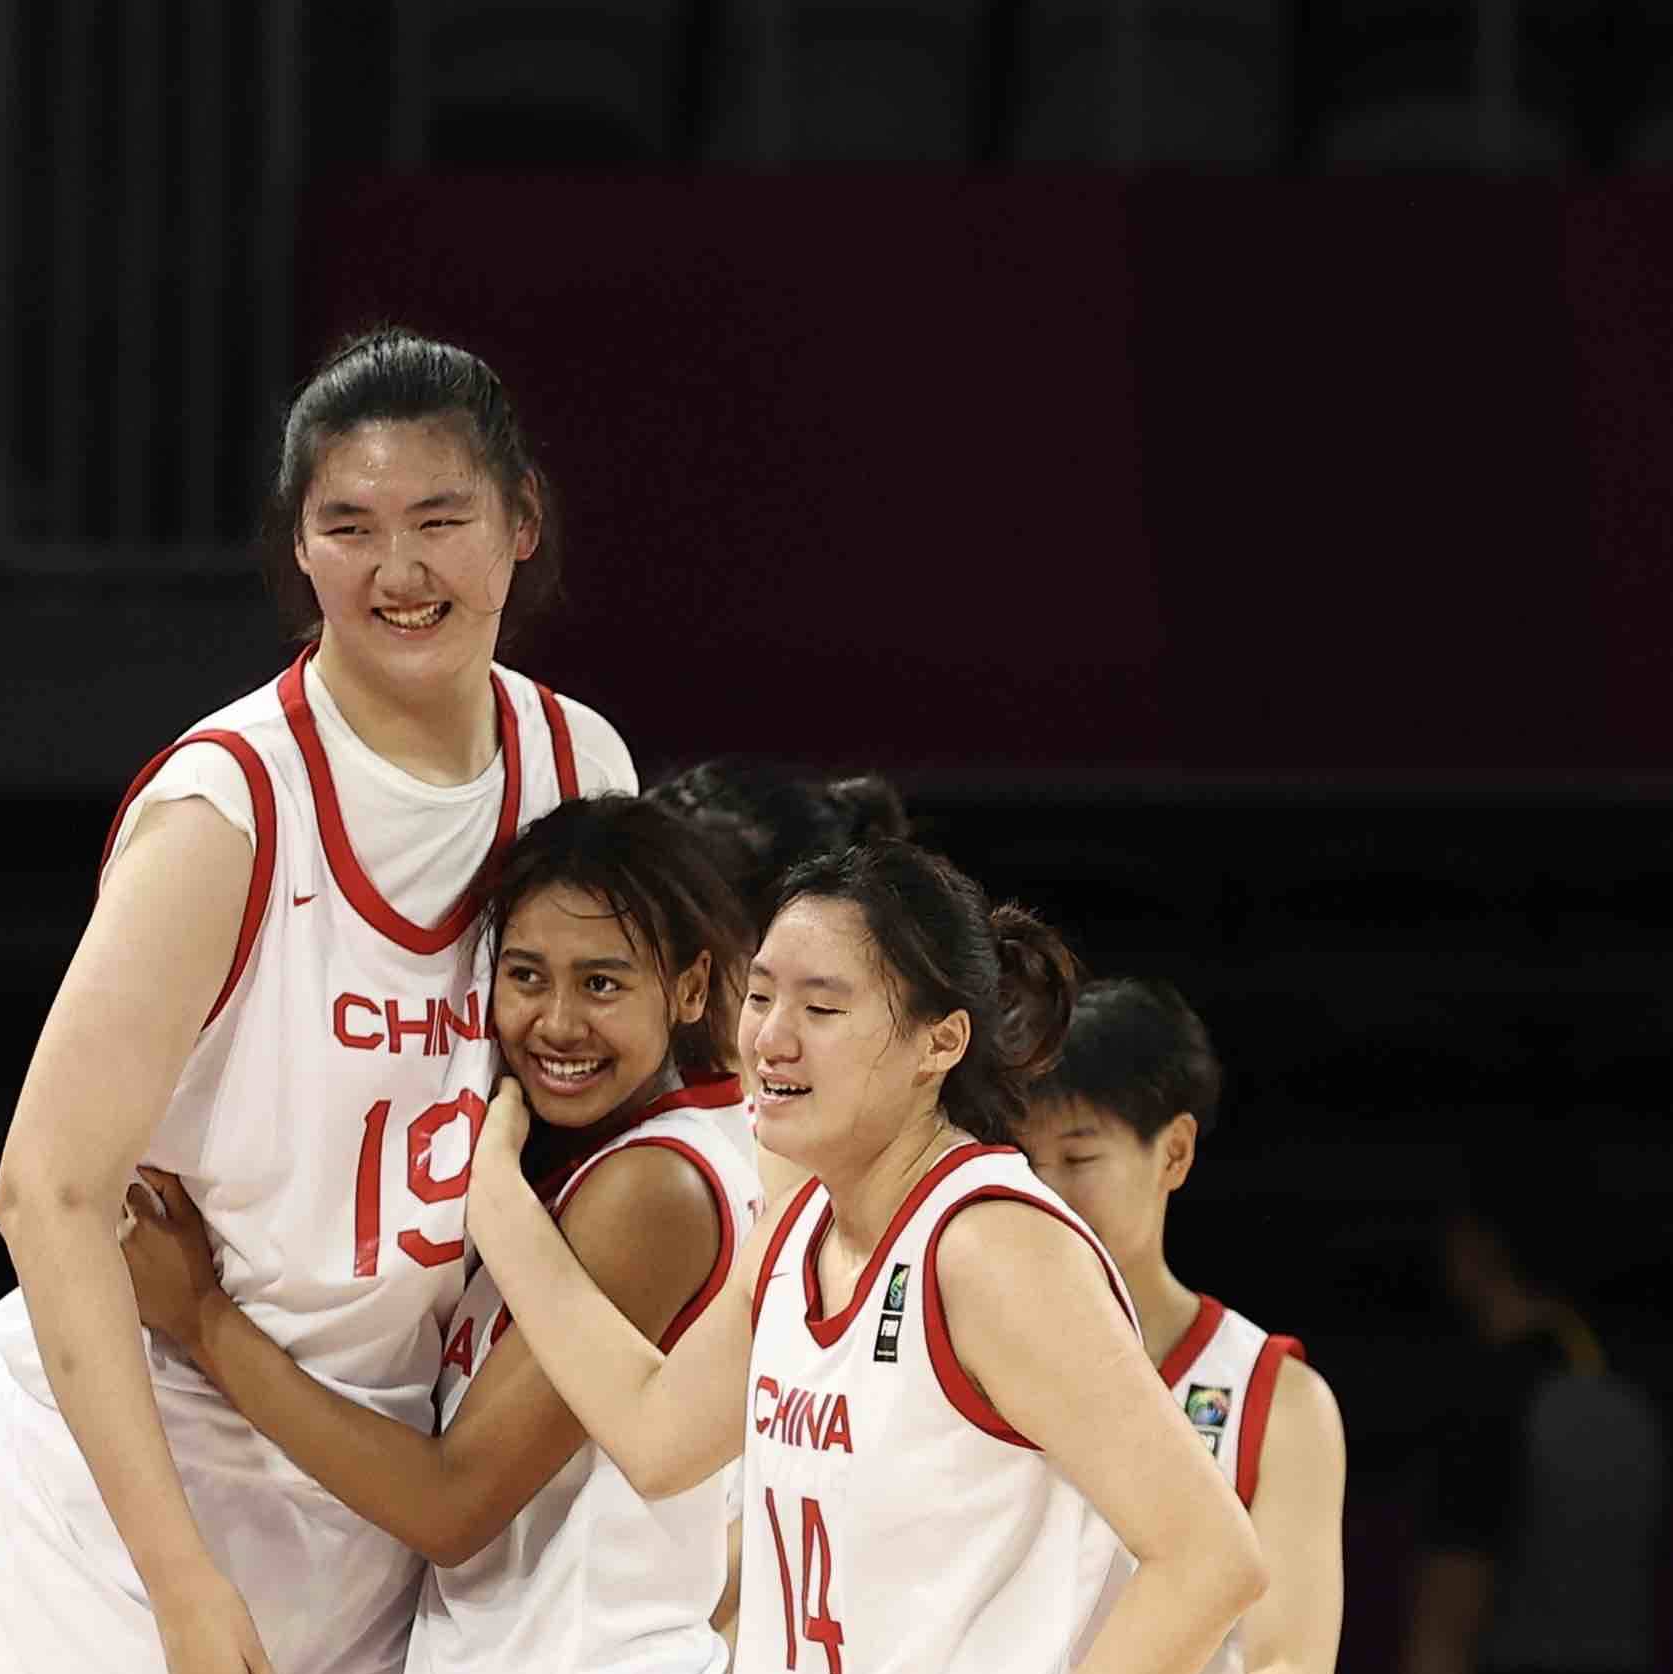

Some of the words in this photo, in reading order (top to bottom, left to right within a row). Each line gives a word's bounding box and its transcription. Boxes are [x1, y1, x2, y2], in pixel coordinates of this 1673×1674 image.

[333, 991, 492, 1056] CHIN
[353, 1088, 487, 1277] 19
[756, 1375, 853, 1453] CHINA
